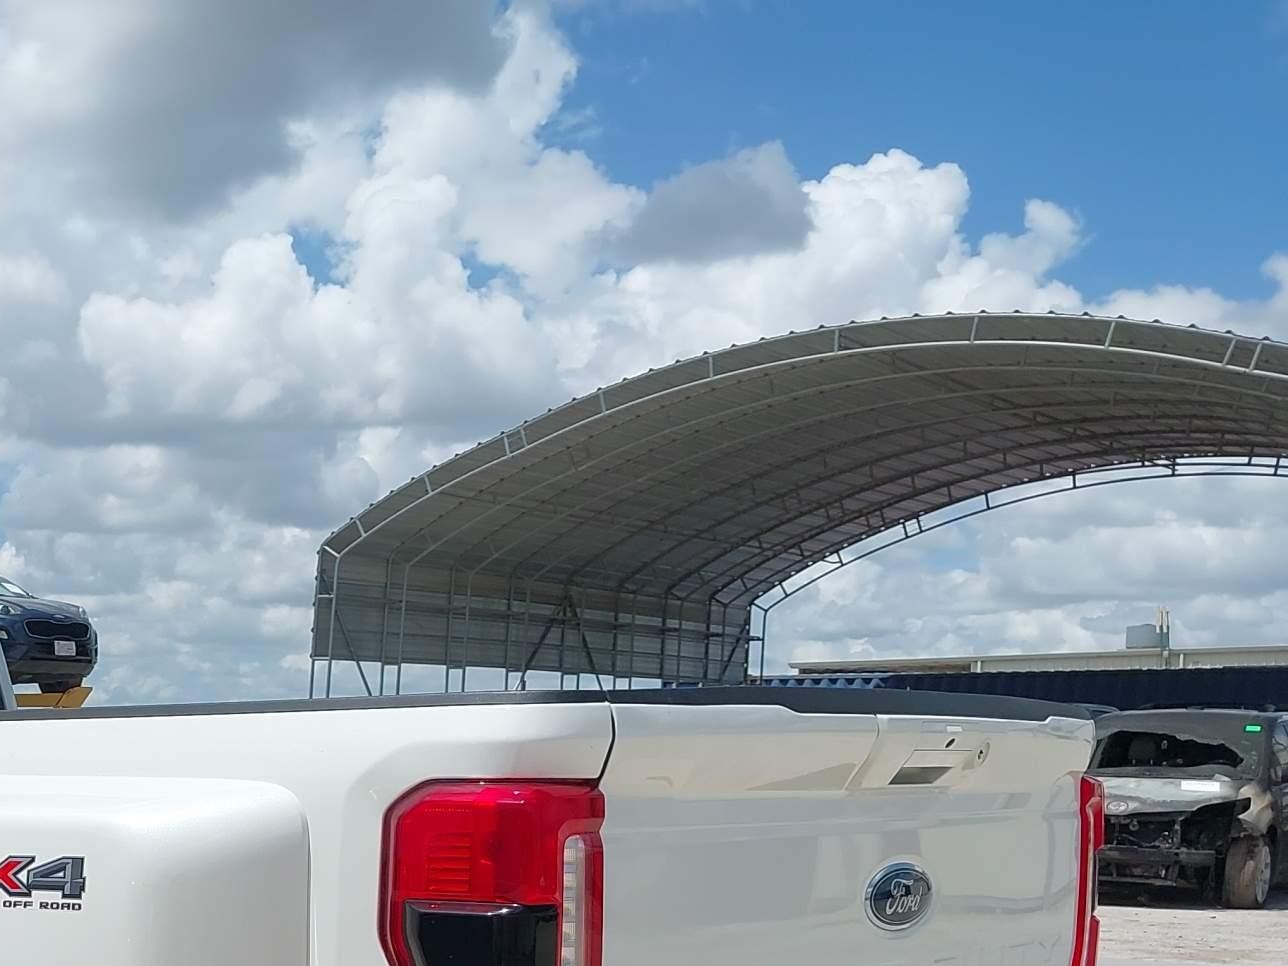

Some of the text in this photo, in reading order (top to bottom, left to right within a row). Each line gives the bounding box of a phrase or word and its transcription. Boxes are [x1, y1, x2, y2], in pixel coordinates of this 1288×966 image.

[2, 900, 82, 911] OFF ROAD
[886, 878, 923, 915] Ford
